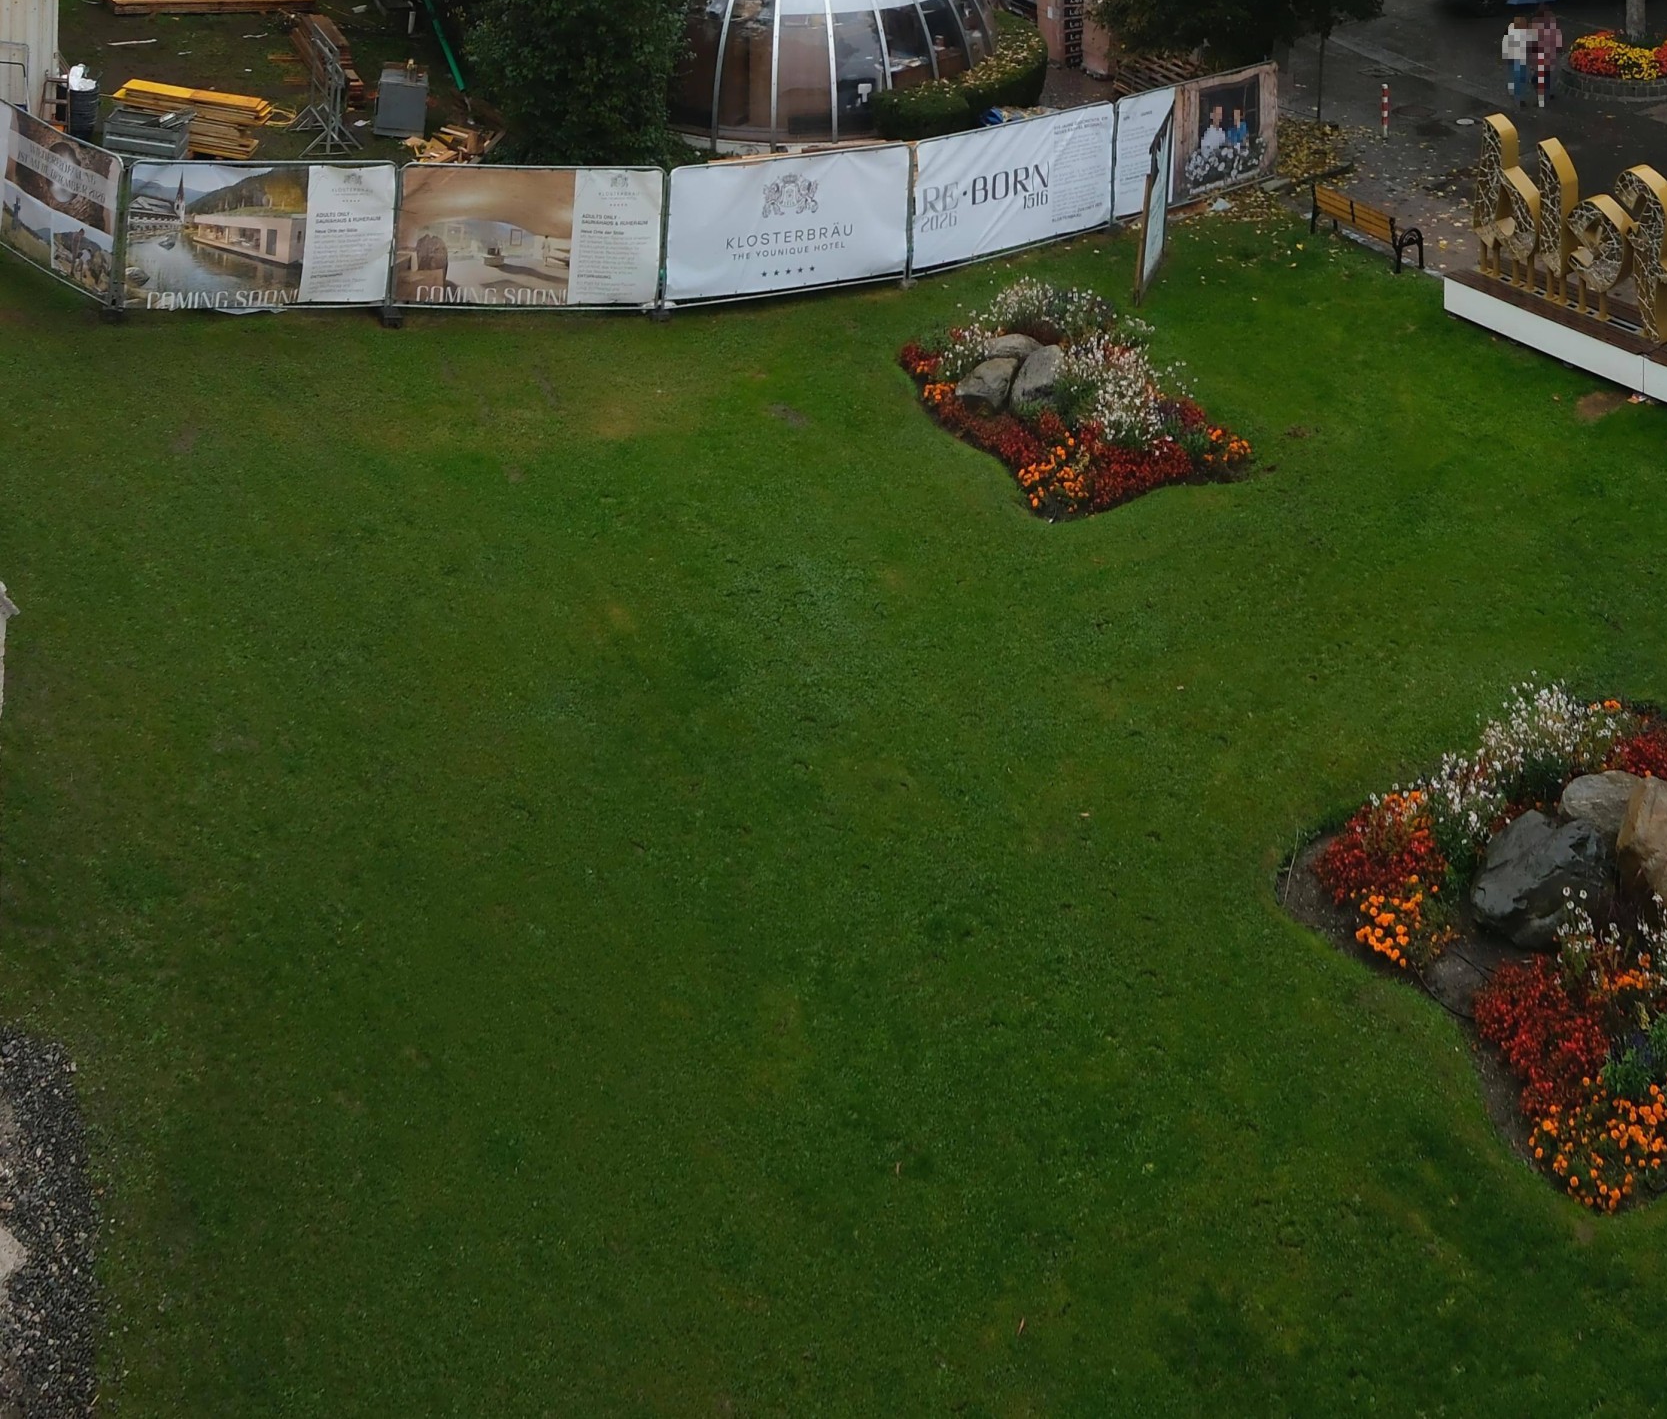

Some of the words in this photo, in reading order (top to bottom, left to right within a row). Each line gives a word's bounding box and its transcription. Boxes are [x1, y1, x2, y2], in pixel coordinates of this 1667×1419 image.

[1022, 188, 1048, 210] 1516
[920, 210, 958, 233] 2026
[726, 222, 854, 250] KLOSTERBRÄU
[732, 252, 750, 261] THE
[756, 245, 809, 258] YOUNIQUE
[814, 241, 845, 252] HOTEL
[146, 290, 229, 309] COMING
[235, 288, 299, 308] SOON!
[415, 286, 497, 304] COMING
[504, 287, 567, 304] SOON!
